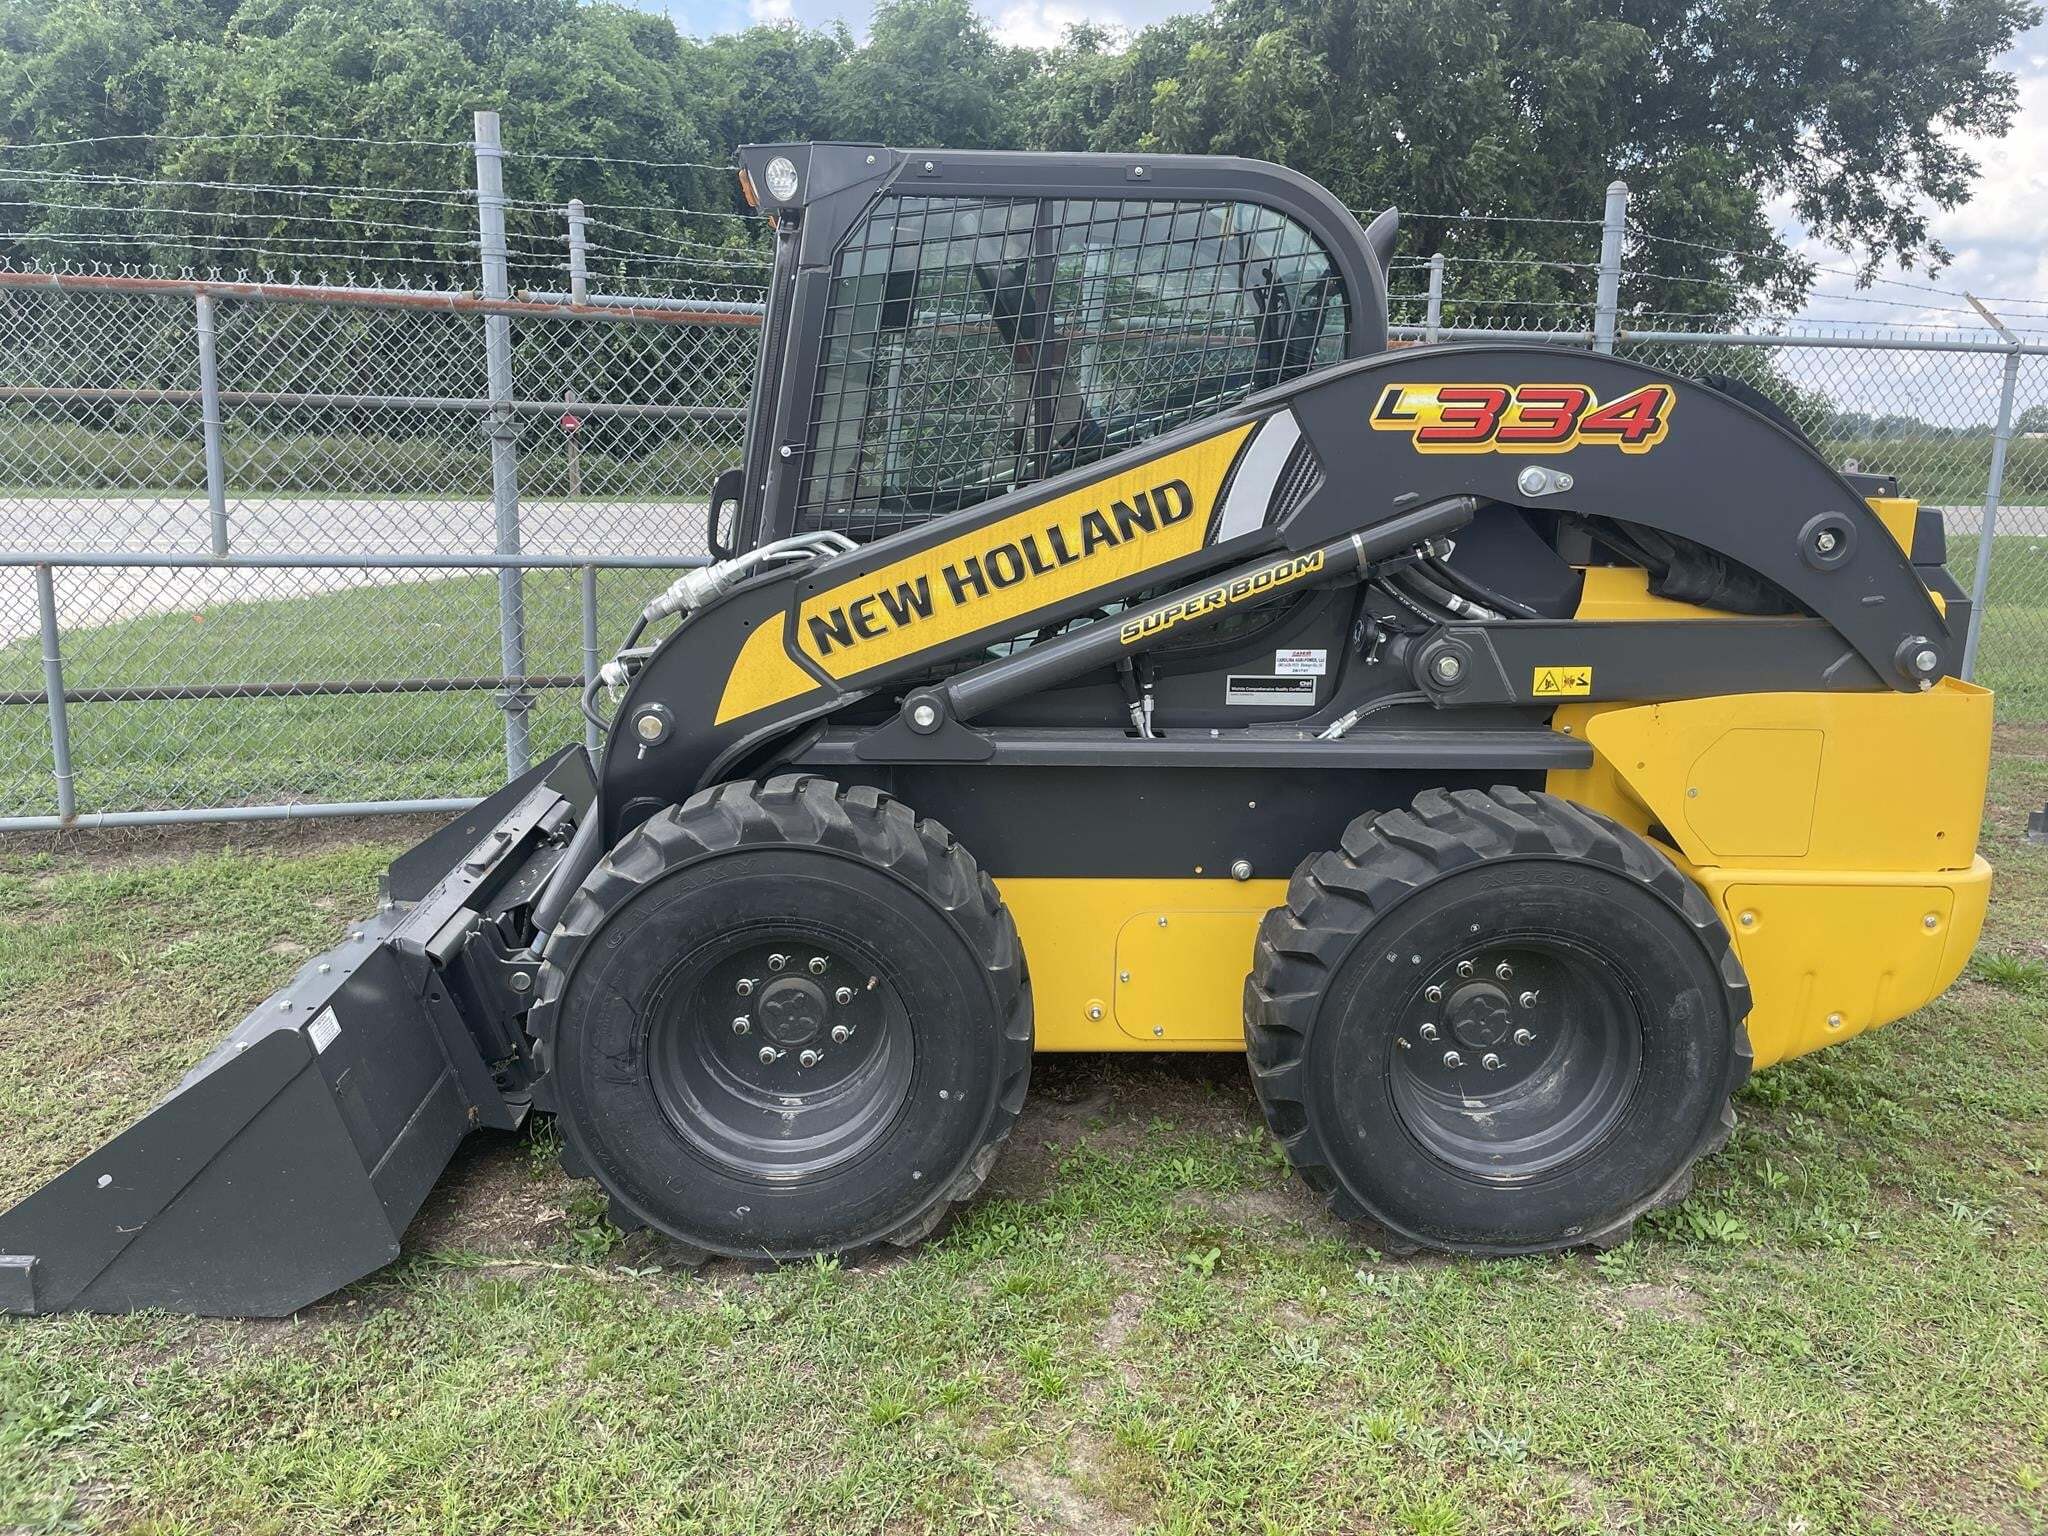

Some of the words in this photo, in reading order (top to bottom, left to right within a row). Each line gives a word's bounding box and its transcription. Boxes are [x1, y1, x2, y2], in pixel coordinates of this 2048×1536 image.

[1370, 384, 1675, 453] L334
[807, 574, 935, 656] NEW
[941, 479, 1194, 606] HOLLAND
[1121, 588, 1226, 643] SUPER
[1230, 550, 1324, 602] BOOM
